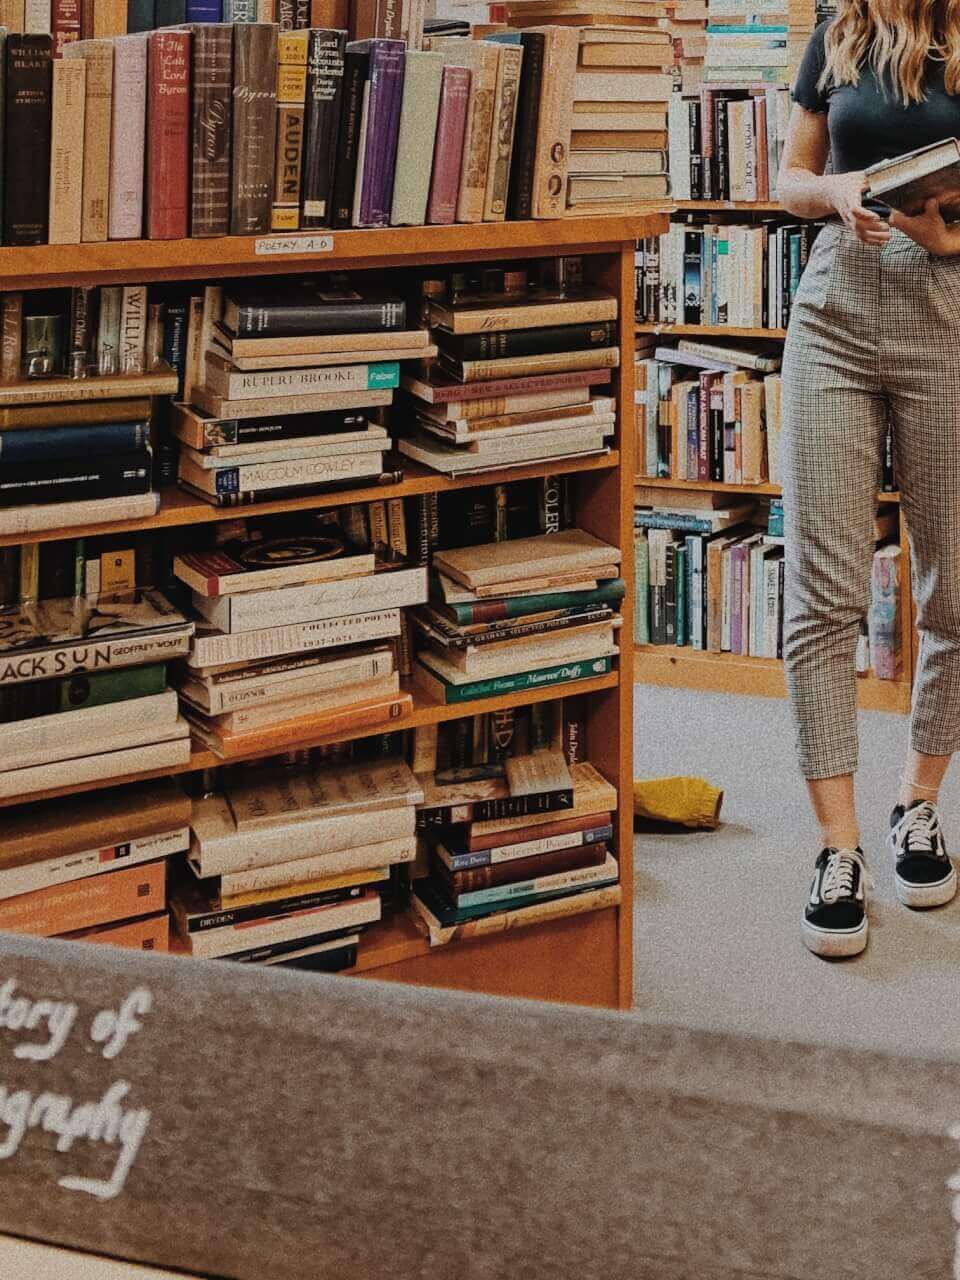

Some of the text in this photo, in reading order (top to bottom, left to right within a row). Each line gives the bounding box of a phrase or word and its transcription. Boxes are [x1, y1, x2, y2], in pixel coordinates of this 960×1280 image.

[232, 86, 276, 103] Byron
[283, 113, 300, 195] AUDEN
[475, 631, 507, 642] GRAHAM
[54, 645, 111, 672] SUN
[112, 643, 152, 656] GEOFFREY
[91, 986, 153, 1060] of
